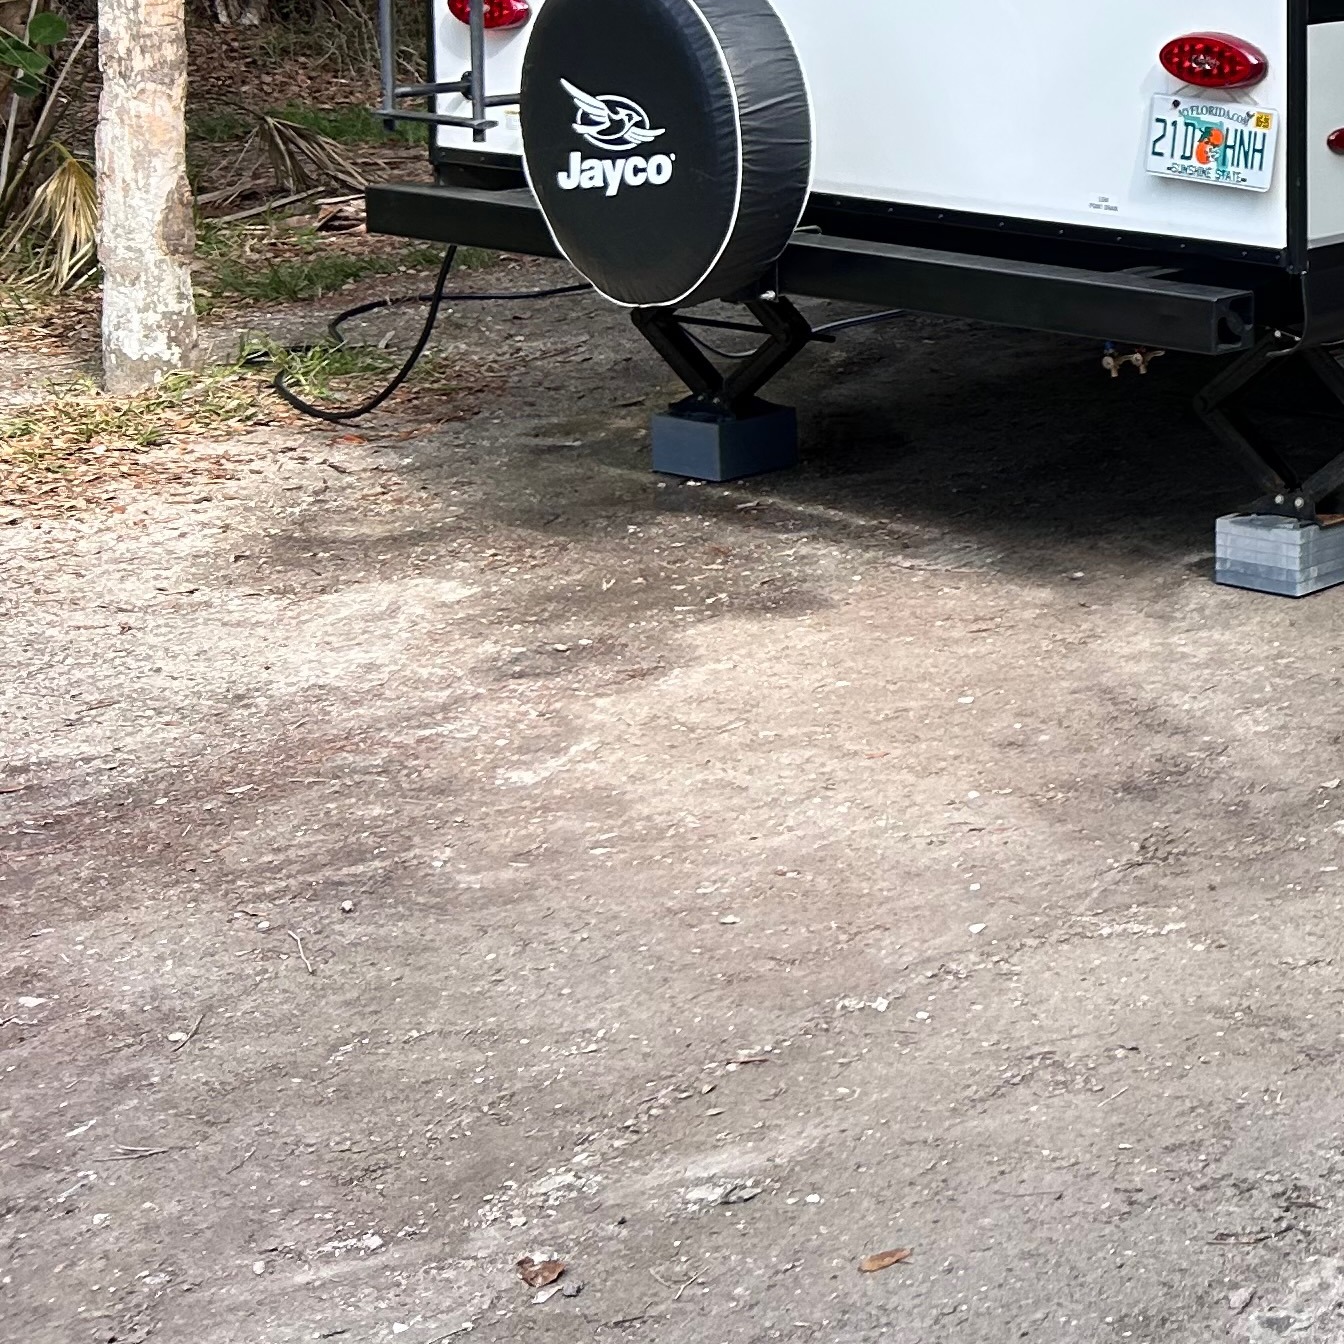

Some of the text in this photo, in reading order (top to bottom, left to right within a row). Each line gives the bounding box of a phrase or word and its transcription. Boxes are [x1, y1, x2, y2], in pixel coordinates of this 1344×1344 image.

[1151, 117, 1267, 172] 21D HNH
[557, 151, 673, 197] Jayco
[1215, 169, 1242, 183] STATE
